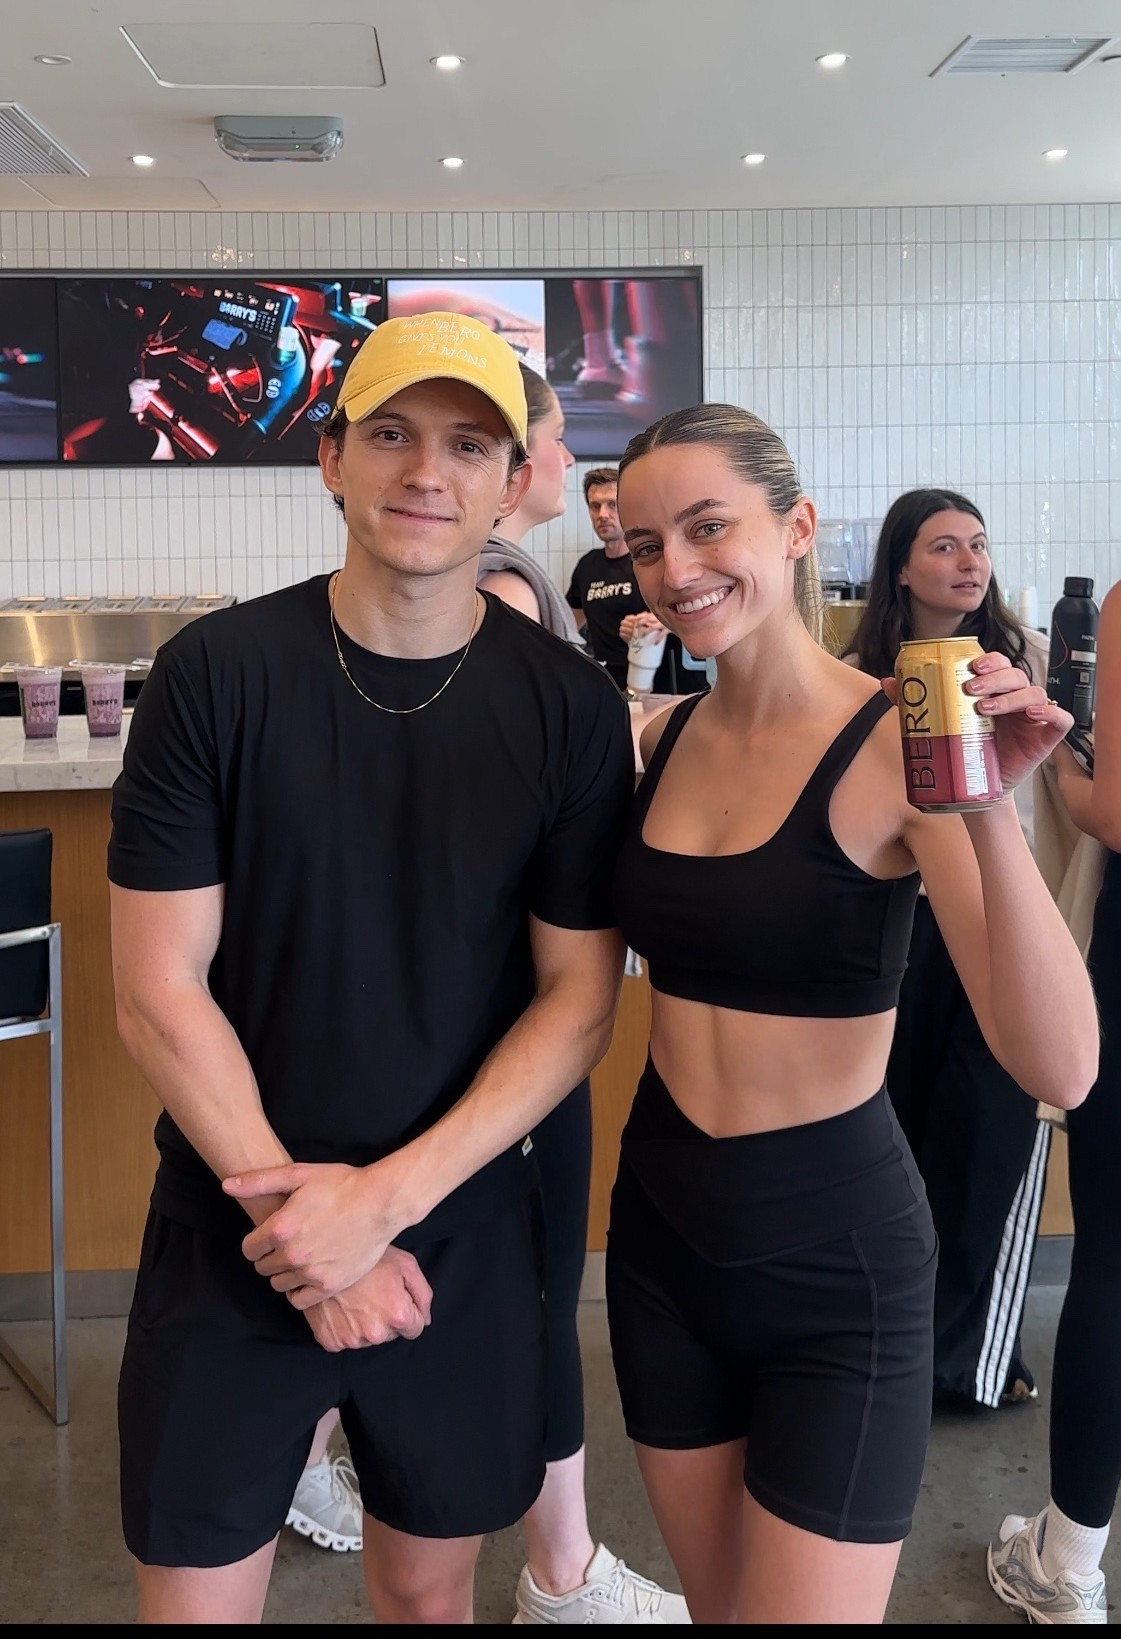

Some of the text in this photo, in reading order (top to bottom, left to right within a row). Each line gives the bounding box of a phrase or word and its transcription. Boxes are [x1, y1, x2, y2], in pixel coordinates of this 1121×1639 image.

[219, 300, 257, 322] BARRY'S
[398, 333, 465, 345] GIVES YOU
[404, 318, 481, 340] WHEN BERO
[416, 342, 488, 369] LEMONS
[587, 582, 632, 601] BARRY'S
[902, 676, 936, 789] BERO
